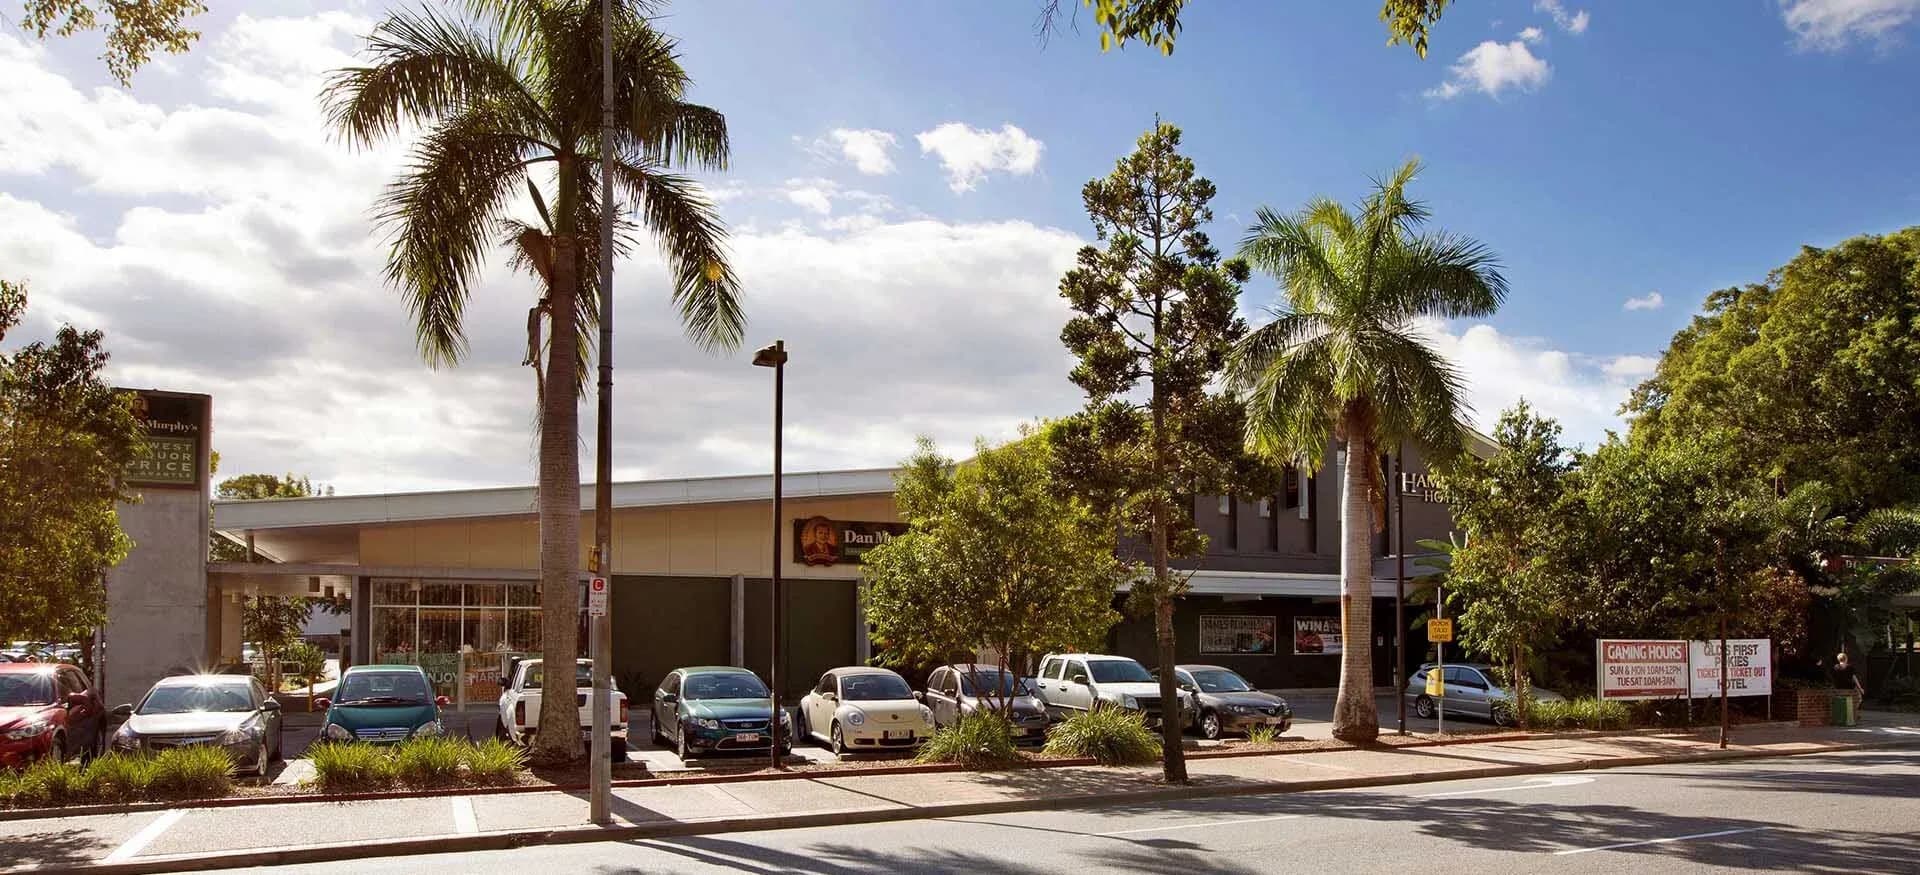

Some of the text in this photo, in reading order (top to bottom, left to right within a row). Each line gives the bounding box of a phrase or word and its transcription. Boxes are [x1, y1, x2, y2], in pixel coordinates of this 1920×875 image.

[149, 442, 192, 451] WEST
[125, 460, 192, 472] PRICE
[844, 530, 873, 544] Dan
[1608, 645, 1682, 659] GAMING HOURS
[1733, 644, 1759, 656] FIRST
[1714, 655, 1749, 667] PKIES
[1609, 665, 1624, 675] SUN
[1625, 665, 1630, 675] &
[1631, 665, 1646, 675] MON
[1696, 668, 1720, 678] TICKET
[1730, 667, 1752, 677] TICKET
[1753, 666, 1766, 677] OUT
[428, 672, 458, 683] NJOY
